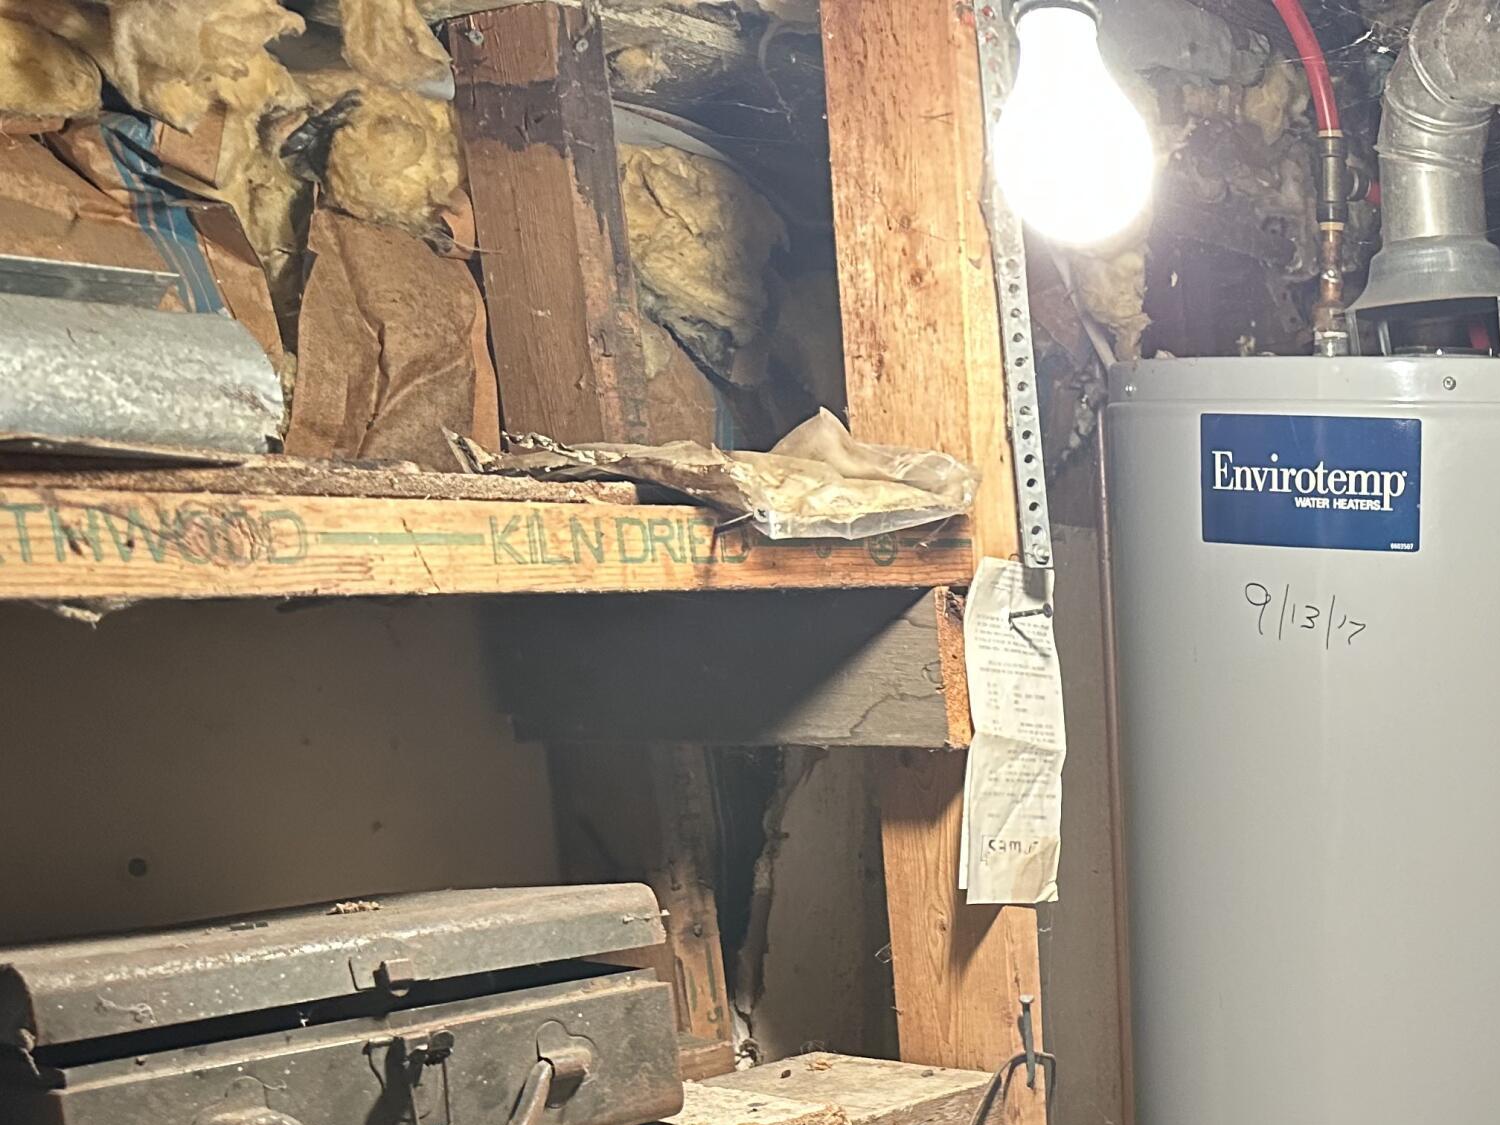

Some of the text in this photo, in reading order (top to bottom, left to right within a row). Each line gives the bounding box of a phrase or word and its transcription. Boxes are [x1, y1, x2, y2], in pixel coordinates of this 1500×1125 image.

[1211, 449, 1408, 512] Envirotemp
[1294, 496, 1330, 509] WATER
[489, 514, 606, 566] KILN
[616, 516, 753, 565] DRIED
